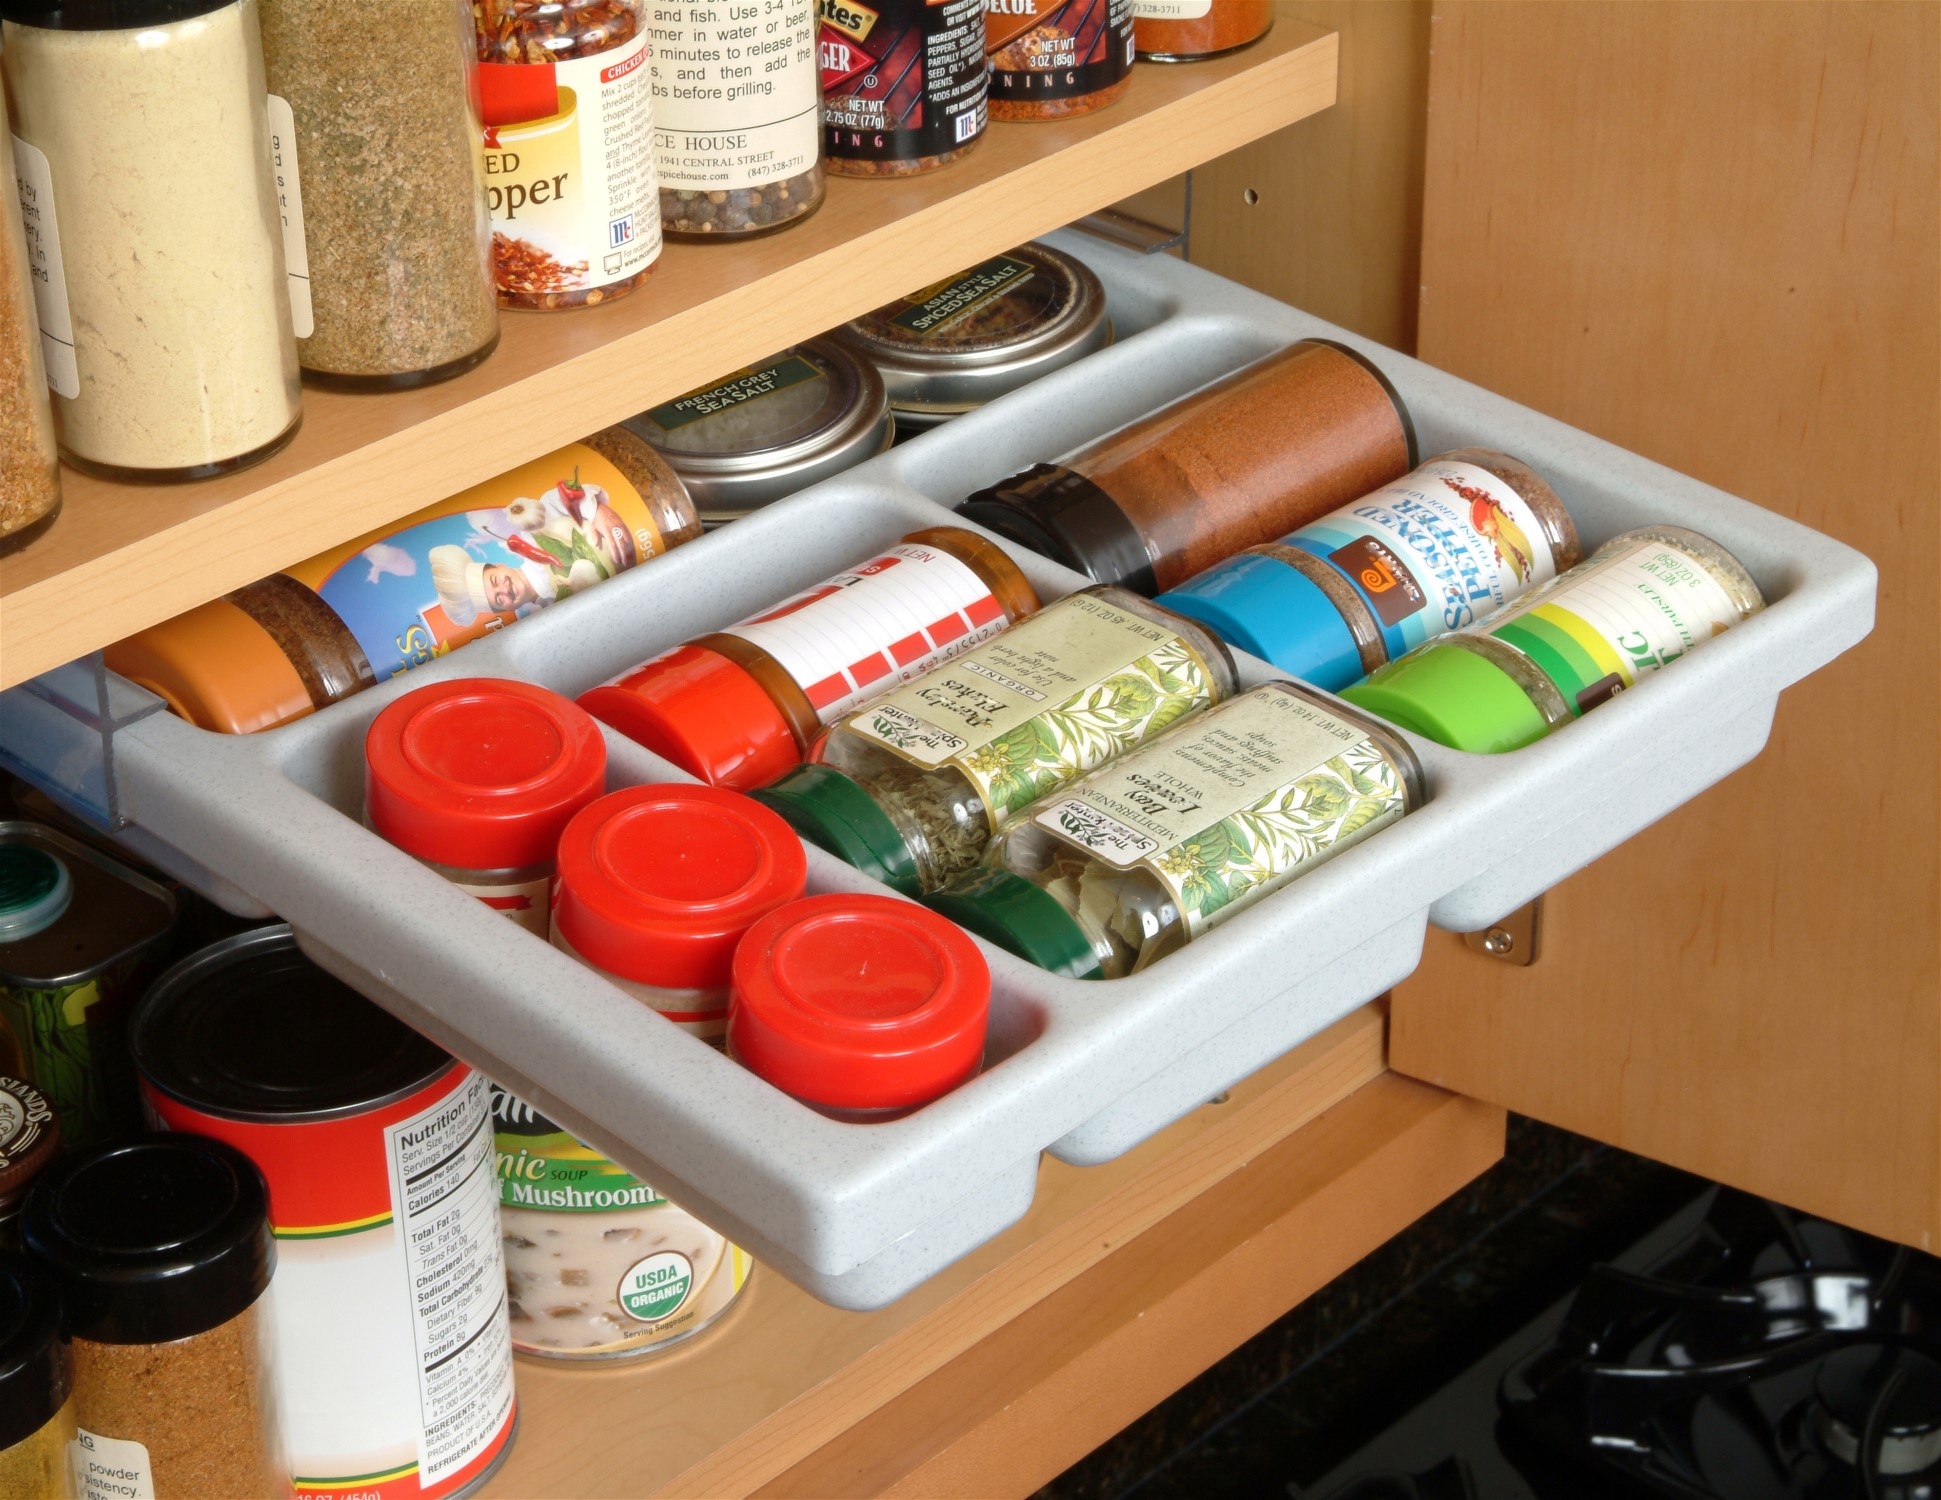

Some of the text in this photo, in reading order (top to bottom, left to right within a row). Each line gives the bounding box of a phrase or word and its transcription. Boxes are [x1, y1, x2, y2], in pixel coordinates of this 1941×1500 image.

[654, 0, 784, 23] and fish. Use 3-4
[1142, 4, 1181, 14] 328-3711
[693, 30, 706, 42] in
[717, 26, 758, 41] water
[765, 21, 779, 34] or
[660, 28, 810, 62] minutes to release the
[820, 41, 851, 72] GER
[1041, 37, 1076, 53] NET WT
[677, 67, 706, 80] and
[720, 66, 752, 80] then
[765, 54, 788, 74] add
[797, 47, 811, 63] the
[927, 50, 960, 68] PARTIALLY
[1030, 51, 1076, 69] 3 OZ (85g)
[927, 67, 946, 80] SEED
[927, 76, 954, 91] AGENTS.
[601, 87, 615, 100] Mix
[602, 91, 635, 112] shredded
[651, 81, 776, 101] bs before grilling.
[602, 103, 635, 123] chopped
[849, 100, 885, 113] NET WT
[945, 103, 959, 116] FOR
[603, 121, 626, 137] green
[826, 111, 885, 130] 2.75 OZ (77g)
[604, 129, 634, 147] Crushed
[685, 134, 748, 151] HOUSE
[605, 148, 620, 160] and
[659, 150, 775, 168] 1941 CENTRAL STREET
[607, 163, 635, 183] another
[747, 155, 805, 180] (847) 328-3711
[607, 176, 637, 195] Sprinkle
[609, 202, 634, 218] cheese
[912, 297, 963, 330] SPICED
[956, 284, 989, 303] SEA
[981, 265, 1018, 287] SALT
[923, 287, 960, 312] ASIAN
[674, 383, 739, 411] FRENCH
[739, 369, 779, 388] GREY
[695, 397, 736, 415] SEA
[731, 380, 776, 401] SALT
[1391, 498, 1492, 603] PEPPER
[1459, 522, 1492, 569] COARSE
[1352, 505, 1474, 631] SEASONED
[1638, 560, 1680, 588] NET WT
[1653, 552, 1702, 588] 3 OZ (85g)
[1635, 583, 1684, 628] PARSLEY
[1140, 630, 1164, 642] NET
[1016, 654, 1045, 670] light
[1033, 650, 1060, 663] note
[1616, 630, 1662, 672] IC
[970, 663, 1036, 697] ORGANIC
[1031, 673, 1053, 688] Use
[1047, 671, 1077, 683] and
[919, 733, 940, 750] The
[1245, 731, 1277, 748] soups
[1331, 726, 1355, 741] NET
[1207, 729, 1284, 766] stuffings and
[1173, 749, 1246, 788] Complements
[1202, 751, 1257, 779] the flavor
[1153, 770, 1204, 801] WHOLE
[1078, 788, 1179, 841] MEDITERRANEAN
[1124, 789, 1171, 816] Bay
[1107, 833, 1129, 851] The
[400, 1101, 466, 1151] Nutrition
[426, 1136, 443, 1152] Size
[403, 1139, 455, 1177] Servings Per
[406, 1179, 433, 1197] Amount
[433, 1170, 446, 1184] Per
[551, 1169, 589, 1181] SOUP
[408, 1172, 461, 1212] Calories 140
[512, 1183, 656, 1209] Mushroom
[411, 1208, 461, 1244] Total Fat 2g
[419, 1231, 451, 1256] Sat. Fat
[421, 1242, 459, 1270] Trans Fat
[416, 1252, 463, 1289] Cholesterol
[635, 1264, 678, 1290] USDA
[417, 1279, 451, 1304] Sodium
[418, 1265, 484, 1319] Total Carbohydrate
[630, 1281, 684, 1308] ORGANIC
[426, 1290, 474, 1331] Dietary Fiber
[427, 1321, 458, 1345] Sugars
[623, 1311, 695, 1341] Serving Suggestion
[423, 1338, 456, 1362] Protein
[425, 1363, 455, 1384] Vitamin
[426, 1374, 458, 1396] Calcium
[432, 1386, 459, 1407] Percent
[426, 1426, 475, 1460] PRODUCT OF
[427, 1416, 497, 1475] REFRIGERATE AFTER
[89, 1462, 141, 1481] powder
